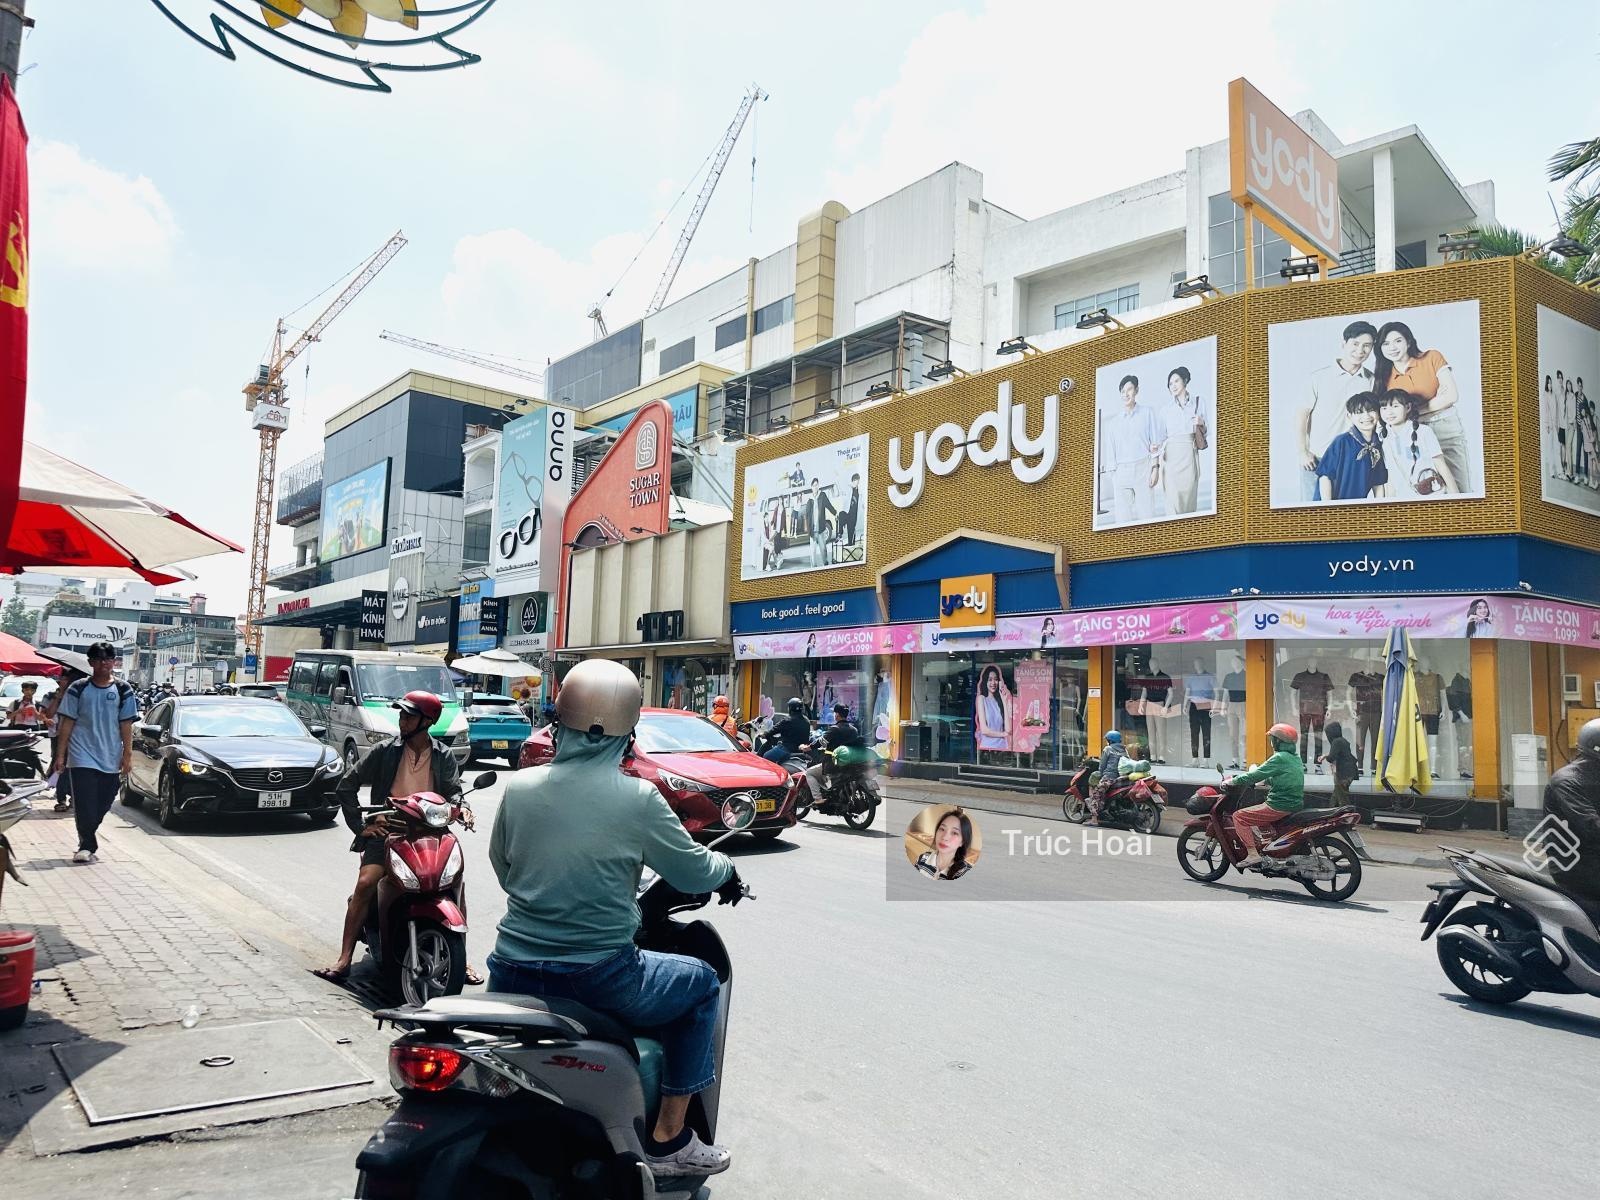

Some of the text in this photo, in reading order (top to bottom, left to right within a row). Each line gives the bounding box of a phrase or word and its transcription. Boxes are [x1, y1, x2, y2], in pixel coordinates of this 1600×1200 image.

[1250, 112, 1334, 241] yody
[549, 411, 565, 481] anna
[887, 380, 1060, 508] yody
[629, 472, 661, 492] SUGAR
[629, 488, 660, 508] TOWN
[1328, 555, 1414, 577] yody.vn
[761, 608, 778, 619] look
[779, 606, 800, 620] good
[805, 603, 821, 615] feel
[822, 601, 845, 616] good
[941, 585, 987, 616] yody
[362, 611, 385, 624] KÍNH
[1117, 614, 1150, 629] SON
[1254, 609, 1306, 630] yody
[1325, 605, 1353, 619] hoa
[1511, 601, 1580, 628] TẶNG SON
[58, 627, 107, 640] IVY moda
[360, 628, 385, 639] HMK
[853, 632, 874, 643] SON
